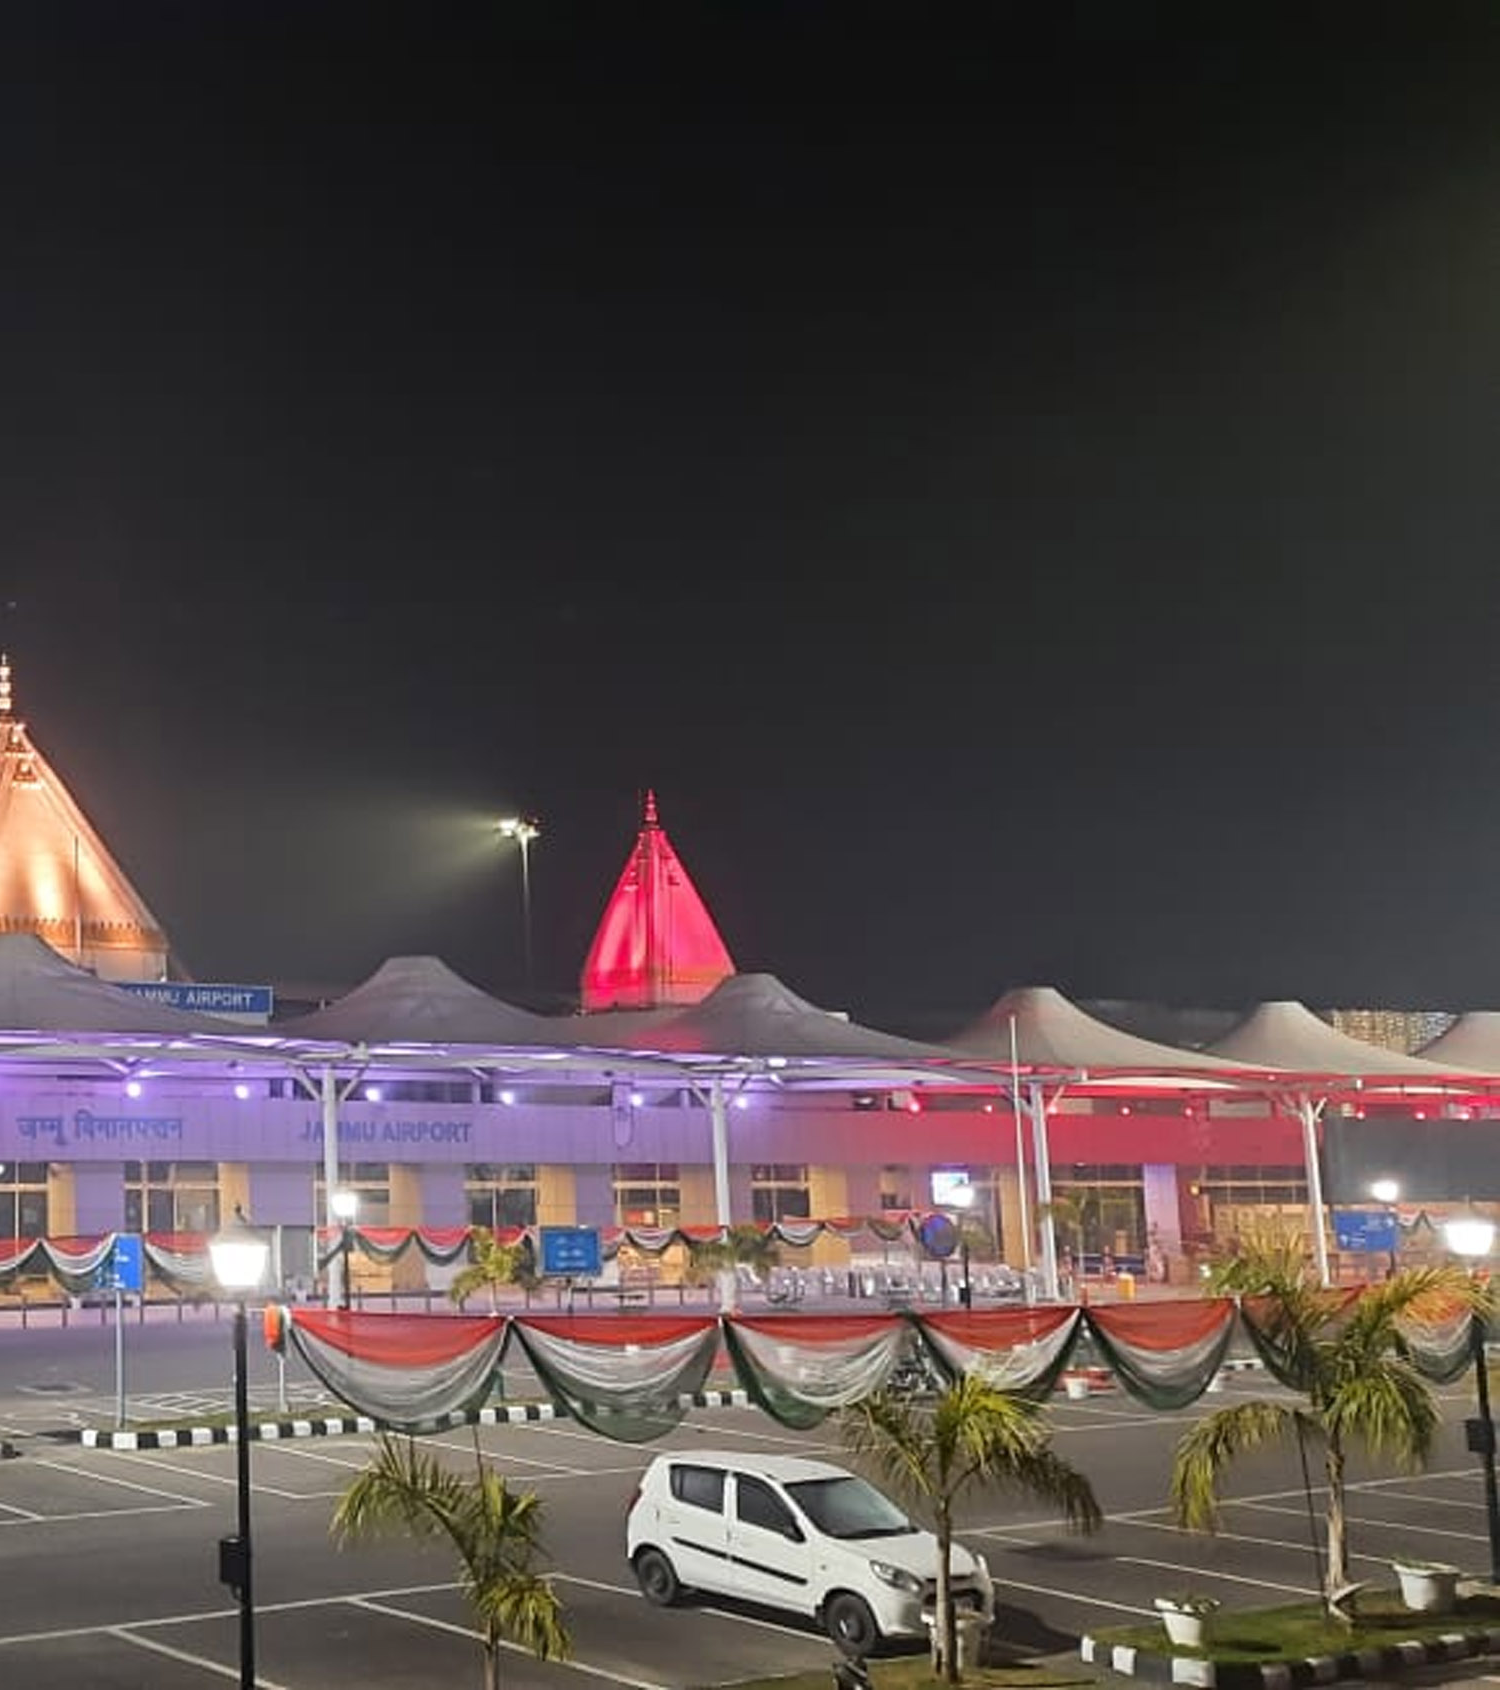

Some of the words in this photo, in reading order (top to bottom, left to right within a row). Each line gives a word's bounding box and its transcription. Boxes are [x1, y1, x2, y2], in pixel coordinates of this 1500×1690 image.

[185, 990, 255, 1009] AIRPORT
[299, 1120, 376, 1143] JAMU
[383, 1121, 472, 1143] AIRPORT
